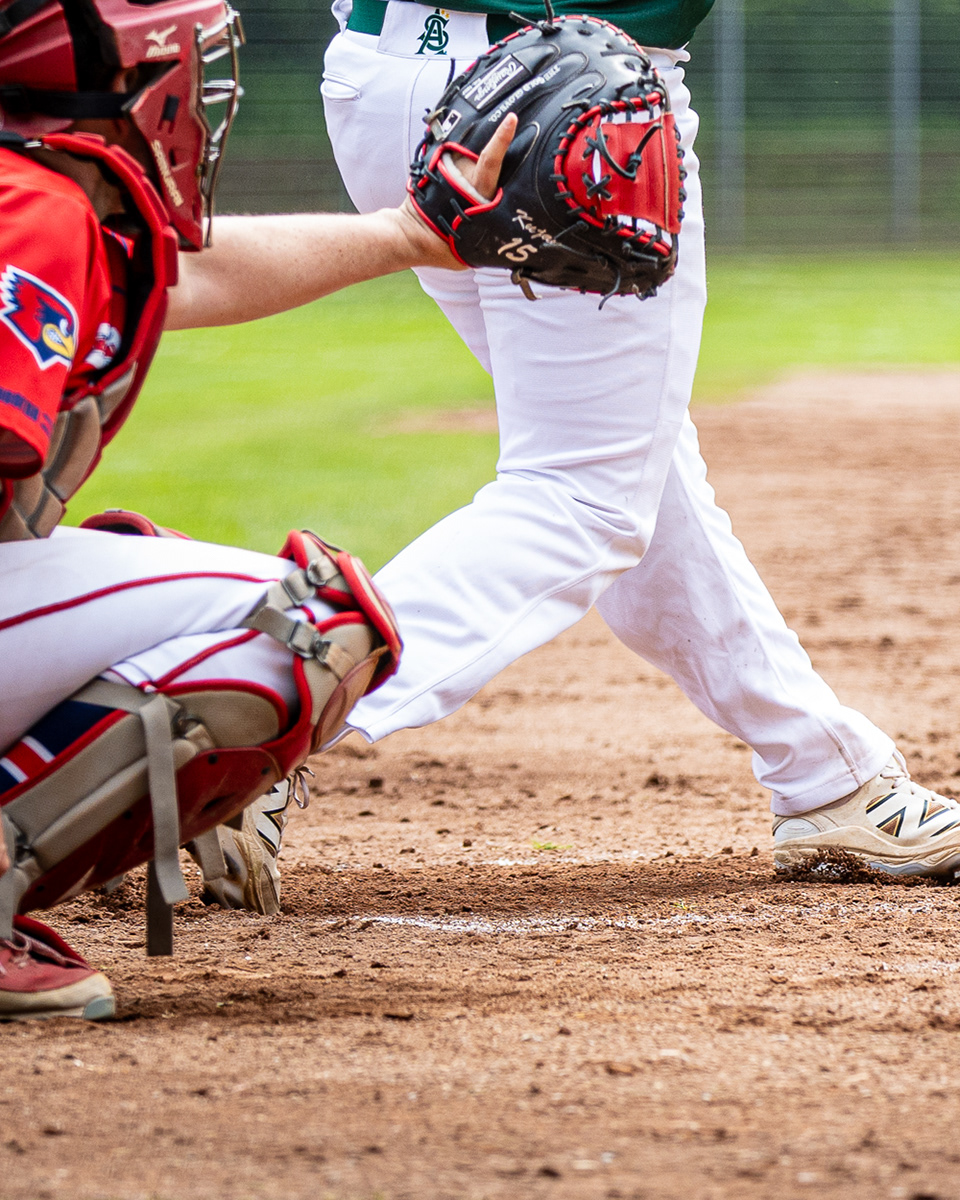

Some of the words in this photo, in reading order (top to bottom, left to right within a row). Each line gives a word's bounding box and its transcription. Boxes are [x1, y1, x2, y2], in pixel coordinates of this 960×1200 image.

[543, 64, 561, 81] THE
[523, 76, 546, 92] GOLD
[500, 88, 523, 112] GLOVE
[497, 237, 538, 262] 15
